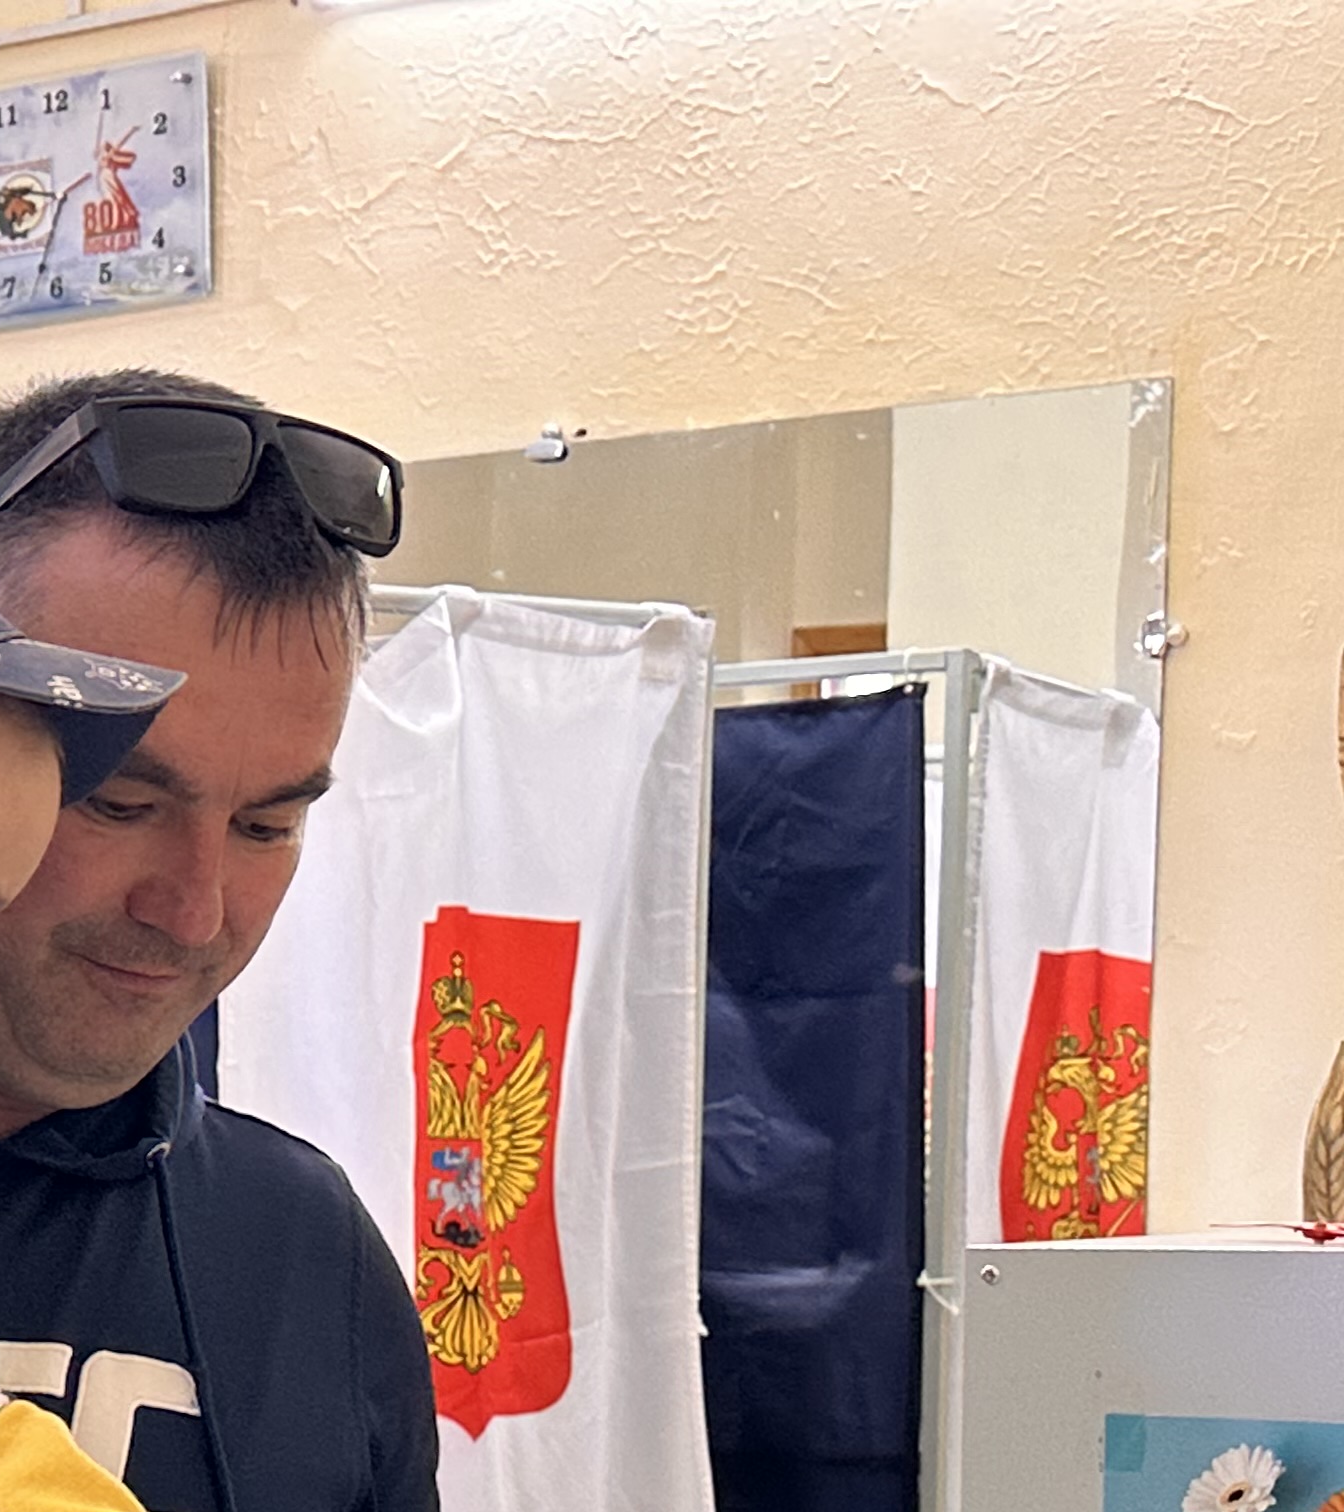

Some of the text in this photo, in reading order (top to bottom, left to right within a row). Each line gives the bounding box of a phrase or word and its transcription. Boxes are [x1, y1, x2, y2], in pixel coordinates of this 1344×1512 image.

[43, 90, 68, 114] 12
[101, 88, 111, 110] 1
[153, 112, 168, 135] 2
[172, 166, 186, 187] 3
[152, 227, 165, 249] 4
[99, 263, 112, 284] 5
[3, 277, 16, 298] 7
[50, 277, 63, 297] 6
